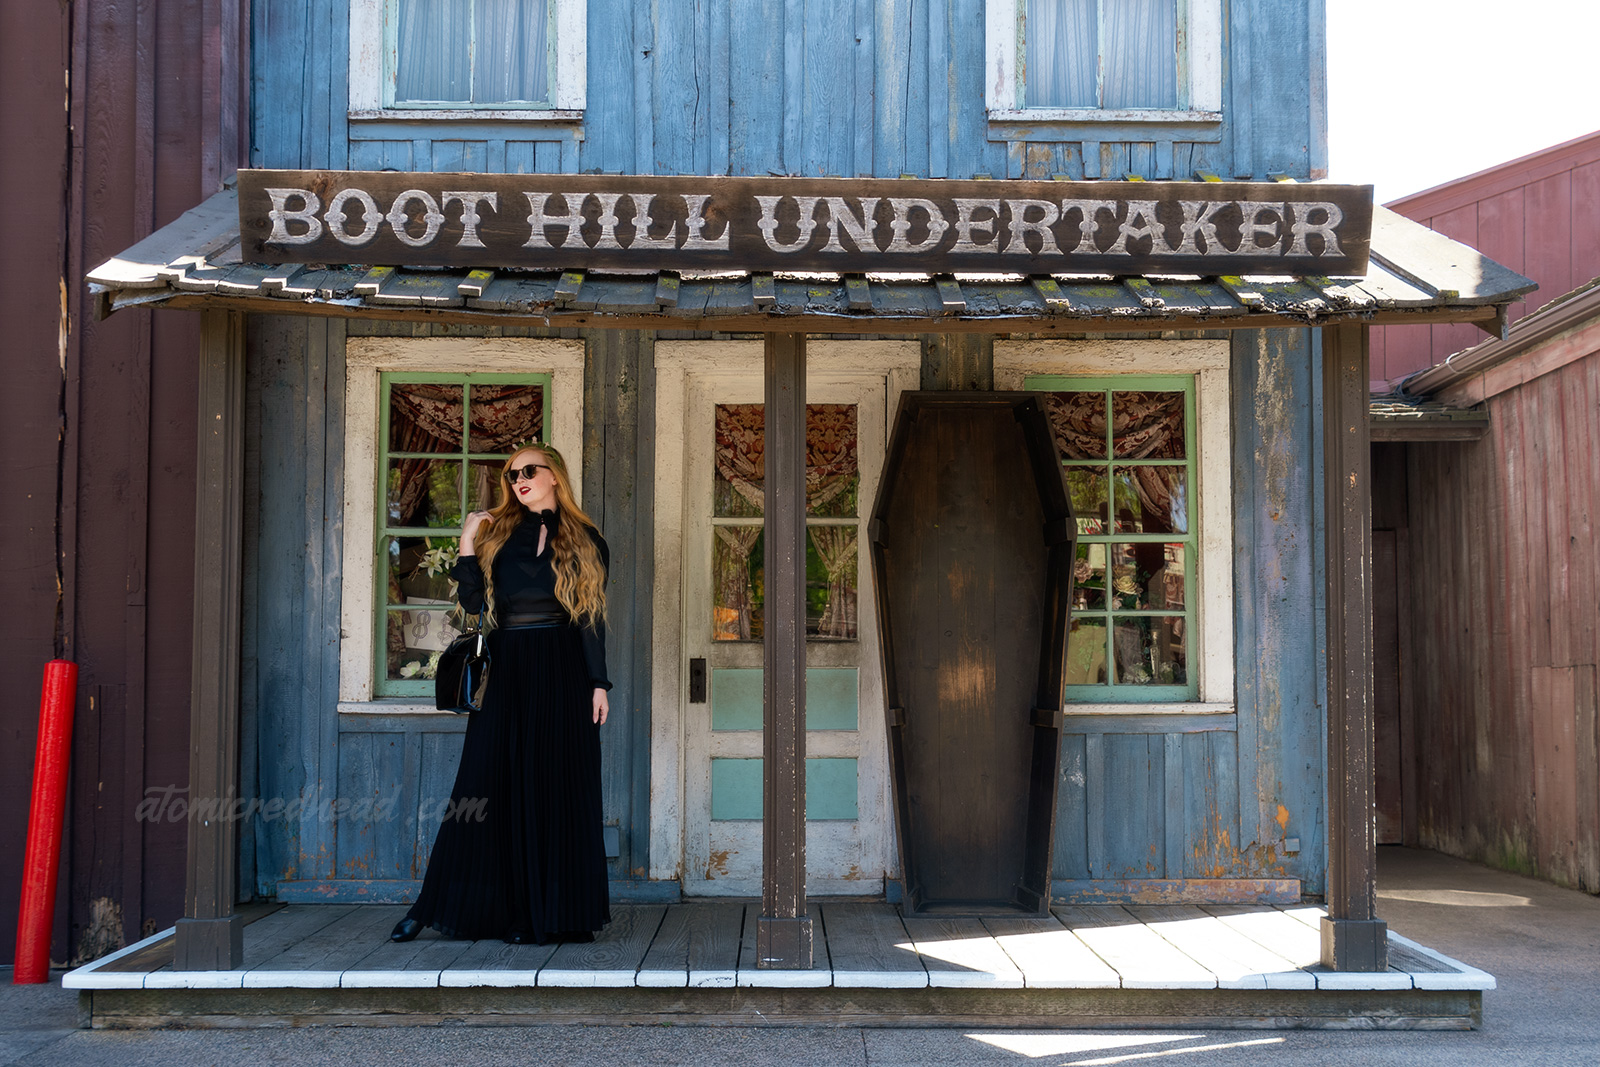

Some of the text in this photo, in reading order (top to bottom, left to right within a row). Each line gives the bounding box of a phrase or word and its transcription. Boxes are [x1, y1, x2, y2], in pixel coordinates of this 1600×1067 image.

[264, 188, 1345, 256] BOOT HILL UNDERTAKER
